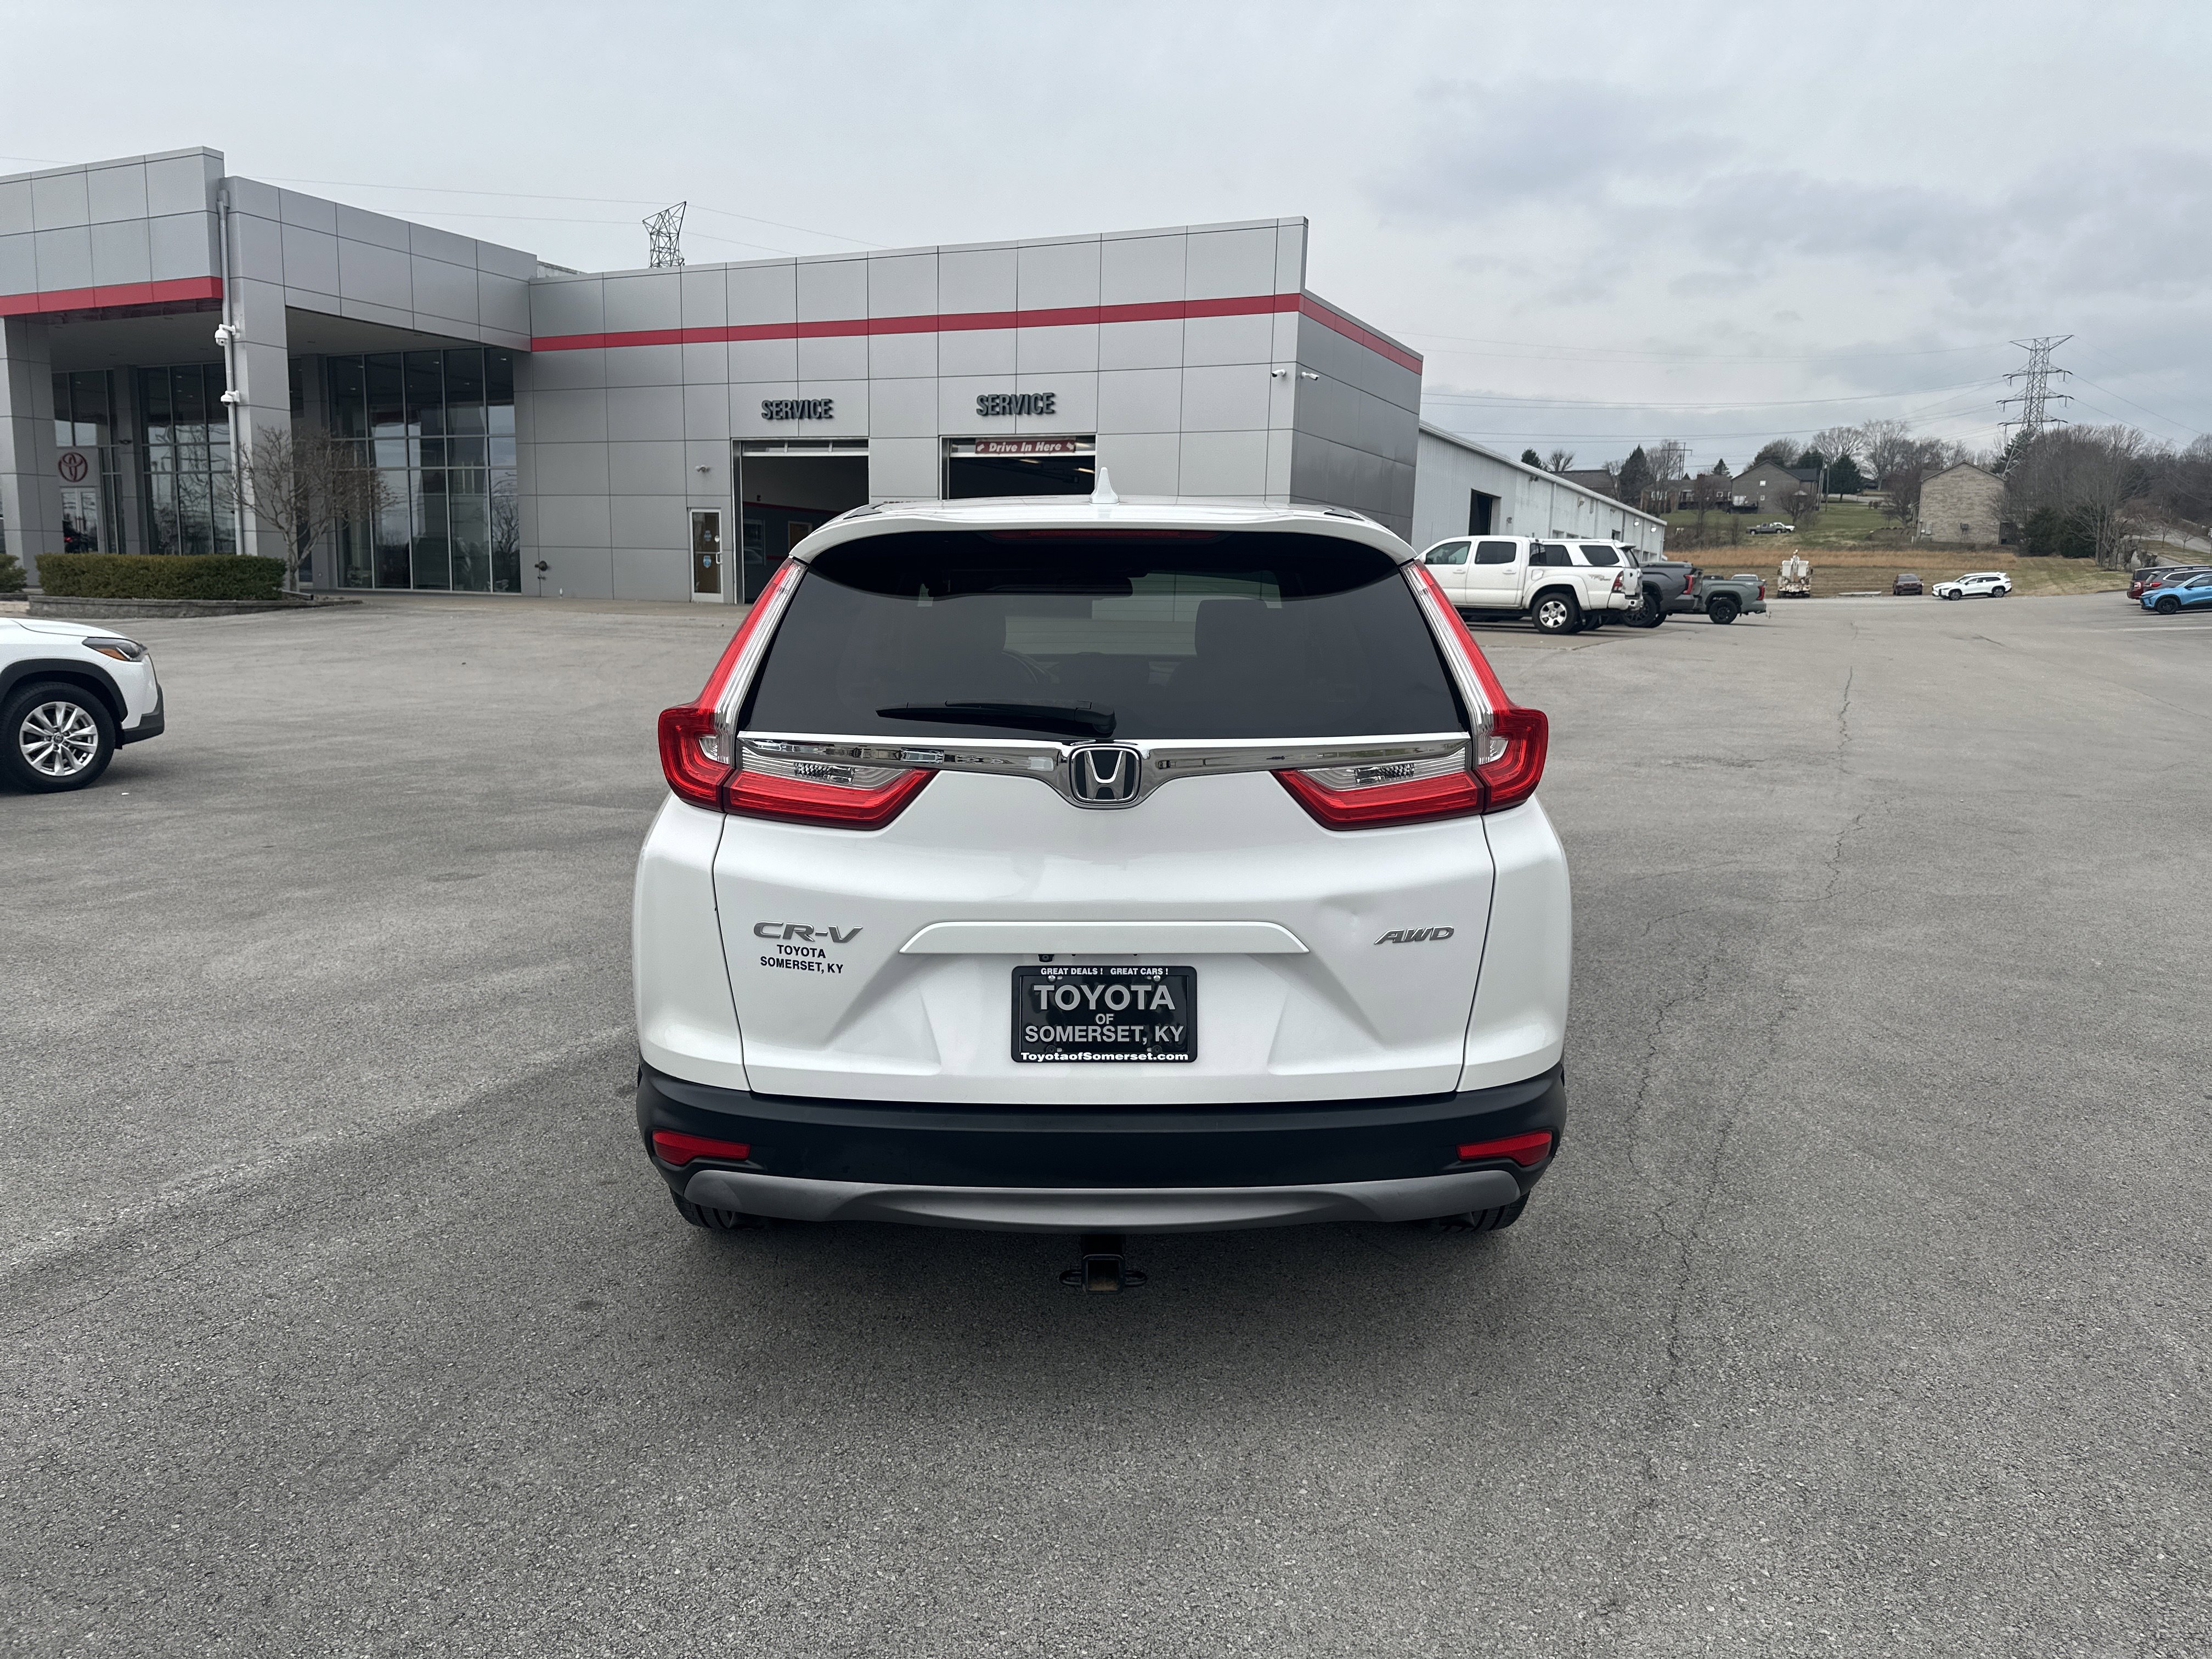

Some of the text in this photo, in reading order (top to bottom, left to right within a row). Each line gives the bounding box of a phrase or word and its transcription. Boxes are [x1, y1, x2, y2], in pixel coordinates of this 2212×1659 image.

[761, 399, 834, 420] SERVICE
[976, 393, 1055, 416] SERVICE
[989, 442, 1062, 452] Drive In Here
[753, 921, 864, 943] CR-V
[1374, 926, 1454, 945] AWD
[777, 944, 826, 958] TOYOTA
[760, 956, 844, 974] SOMERSET, KY
[1034, 985, 1176, 1011] TOYOTA
[1095, 1013, 1114, 1024] OF
[1025, 1025, 1184, 1045] SOMERSET, KY
[1020, 1052, 1188, 1063] ToyotaofSomerset.com
